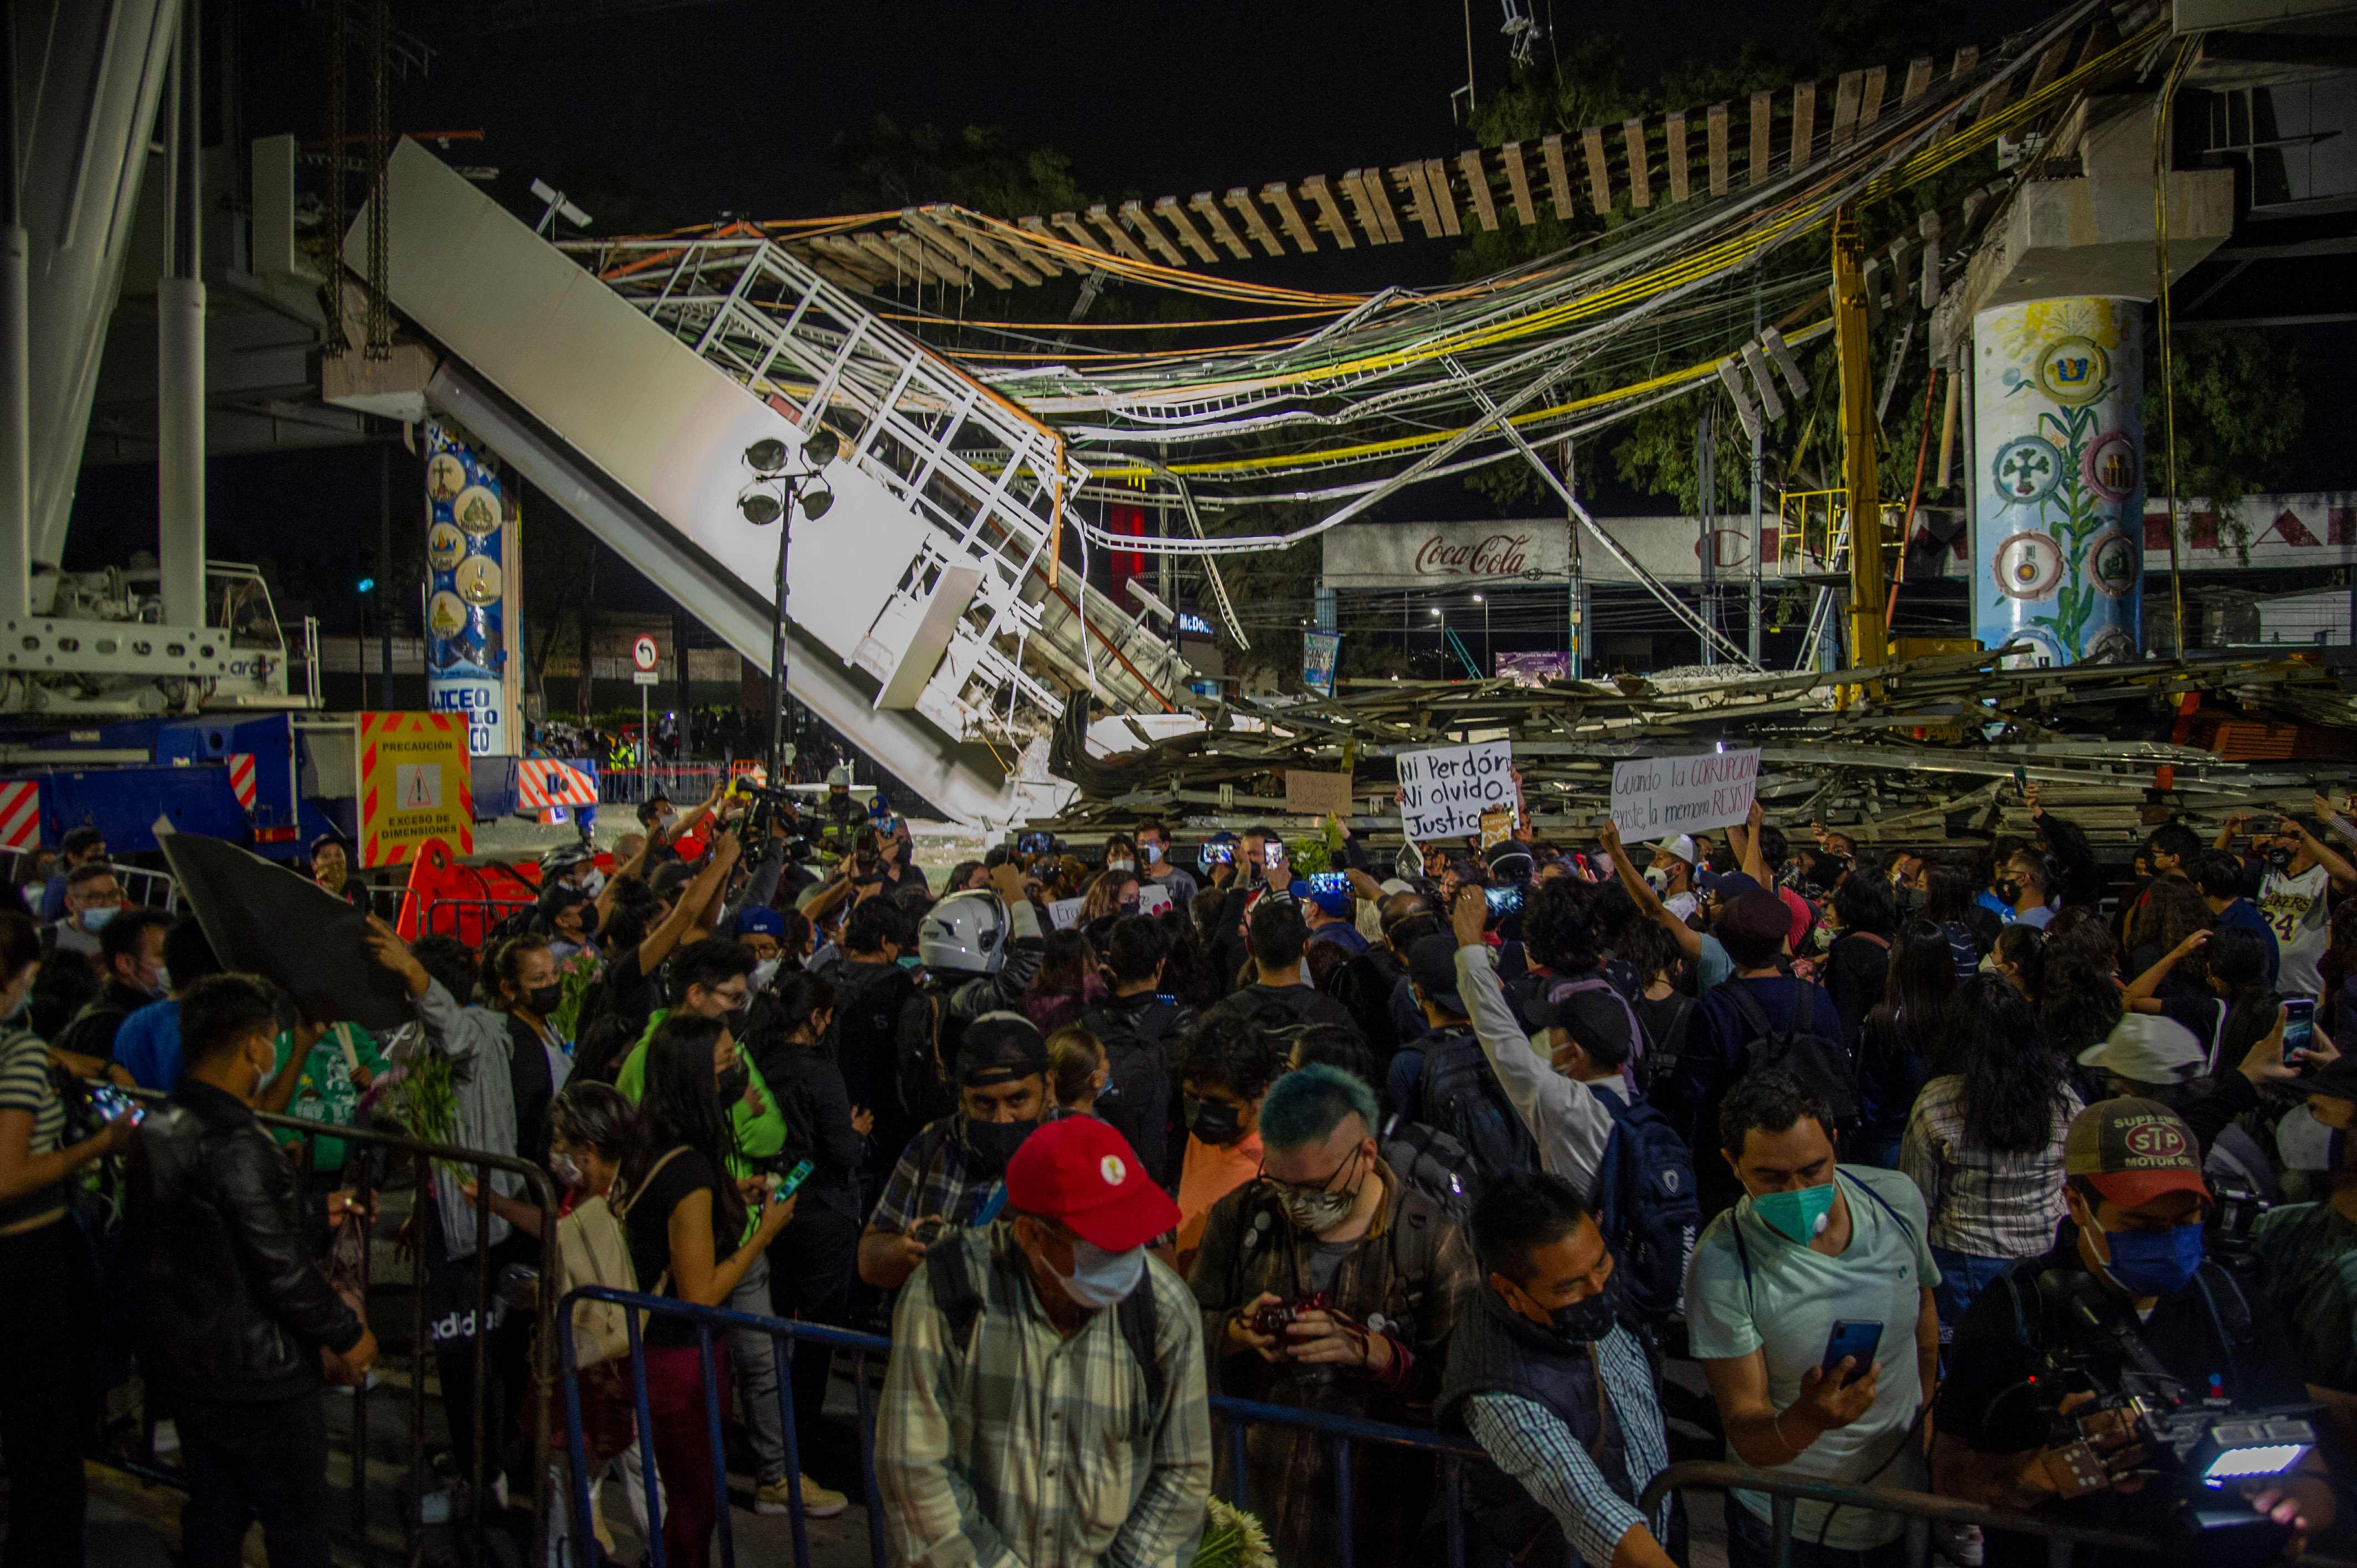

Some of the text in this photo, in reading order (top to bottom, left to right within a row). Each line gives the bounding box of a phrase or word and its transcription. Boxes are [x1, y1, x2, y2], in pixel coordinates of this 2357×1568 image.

[431, 689, 490, 709] LICEO
[1399, 749, 1510, 783] Ni Perdón
[1615, 763, 1661, 795] Cuando
[1672, 761, 1685, 787] la
[1403, 785, 1422, 808] Ni
[1649, 797, 1658, 826] la
[1712, 780, 1755, 816] RESISTE
[382, 824, 457, 839] DIMENSIONES
[389, 814, 450, 827] EXCESO DE
[2256, 890, 2311, 912] AKERS
[2134, 1127, 2179, 1151] STP
[2124, 1156, 2176, 1167] MOTOR
